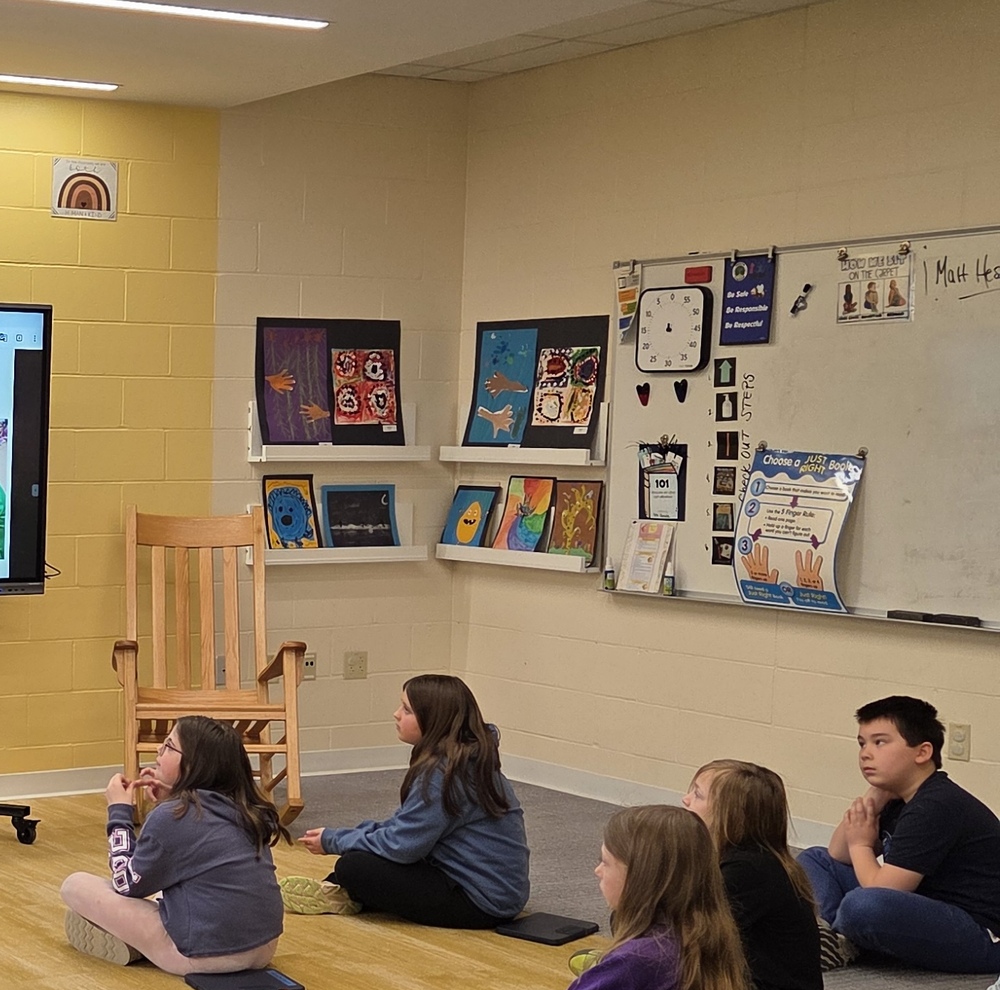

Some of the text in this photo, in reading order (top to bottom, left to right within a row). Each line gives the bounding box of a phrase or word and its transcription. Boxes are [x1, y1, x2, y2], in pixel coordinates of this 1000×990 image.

[841, 258, 866, 271] HOW
[868, 256, 885, 268] WE
[849, 267, 899, 280] ON THE CARPET
[936, 256, 969, 287] Matt
[736, 290, 749, 298] Safe
[656, 298, 660, 306] 5
[684, 296, 690, 304] 55
[735, 305, 768, 313] Responsible
[734, 320, 763, 329] Respectful
[741, 372, 755, 421] STEPS
[741, 430, 750, 459] OUT
[763, 455, 792, 466] Choose
[804, 455, 827, 464] JUST
[799, 463, 826, 474] RIGHT
[655, 479, 669, 488] 101
[756, 482, 760, 492] 1
[748, 502, 756, 513] 2
[786, 509, 802, 517] Finger
[742, 540, 748, 551] 3
